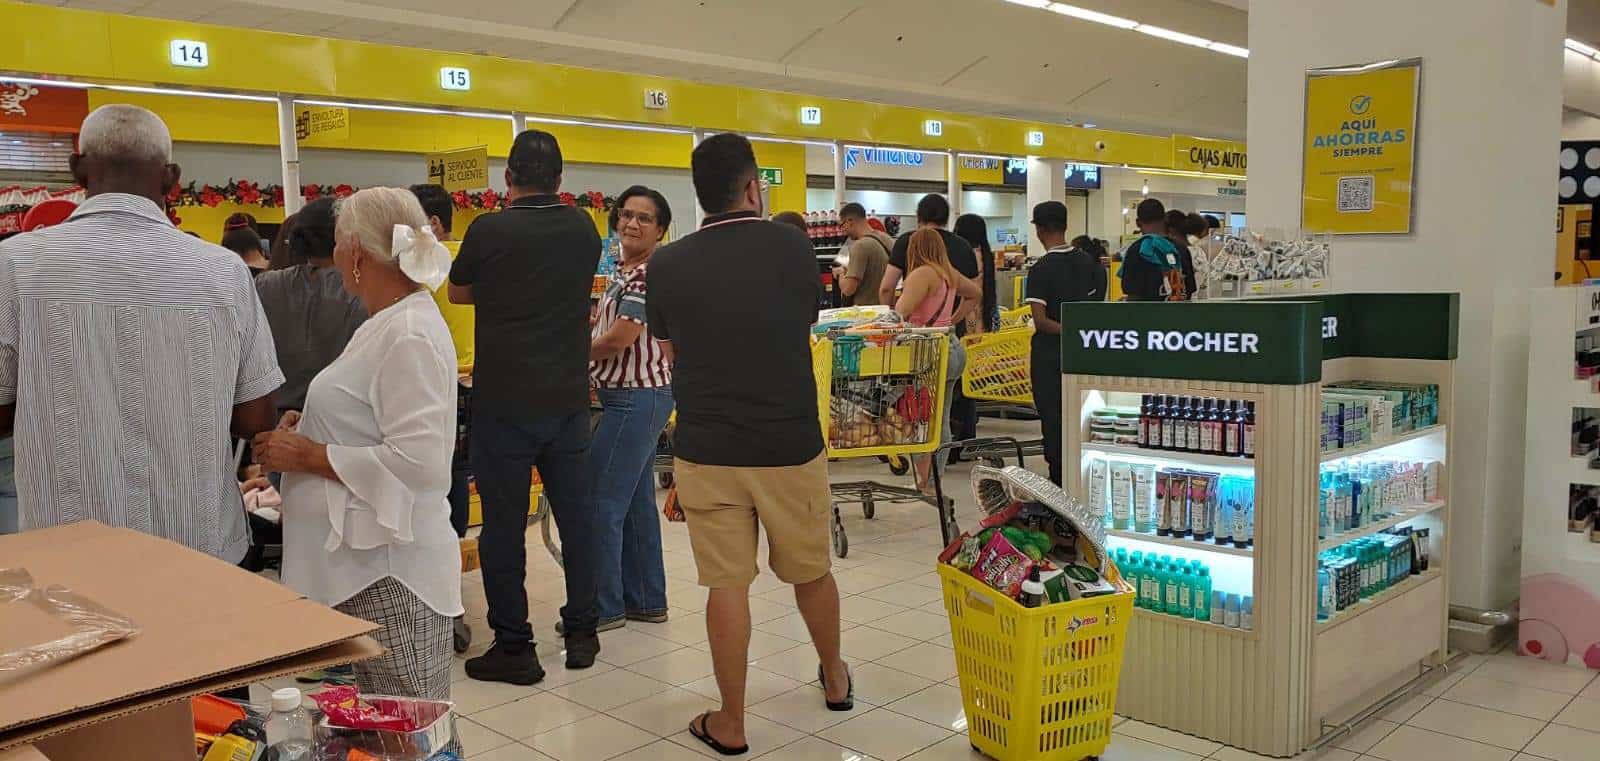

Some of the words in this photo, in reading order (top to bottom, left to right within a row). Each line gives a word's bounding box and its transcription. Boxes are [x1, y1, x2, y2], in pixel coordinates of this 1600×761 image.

[178, 44, 203, 64] 14
[448, 70, 467, 86] 15
[650, 92, 665, 106] 16
[807, 109, 818, 121] 17
[931, 122, 941, 134] 18
[1341, 117, 1376, 131] AQUÍ
[1313, 129, 1406, 148] AHORRAS
[1190, 147, 1220, 169] CAJAS
[1222, 152, 1247, 169] AUTO
[1333, 146, 1384, 158] SIEMPRE
[447, 172, 457, 182] AL
[1079, 329, 1139, 350] YVES
[1147, 331, 1259, 353] ROCHER
